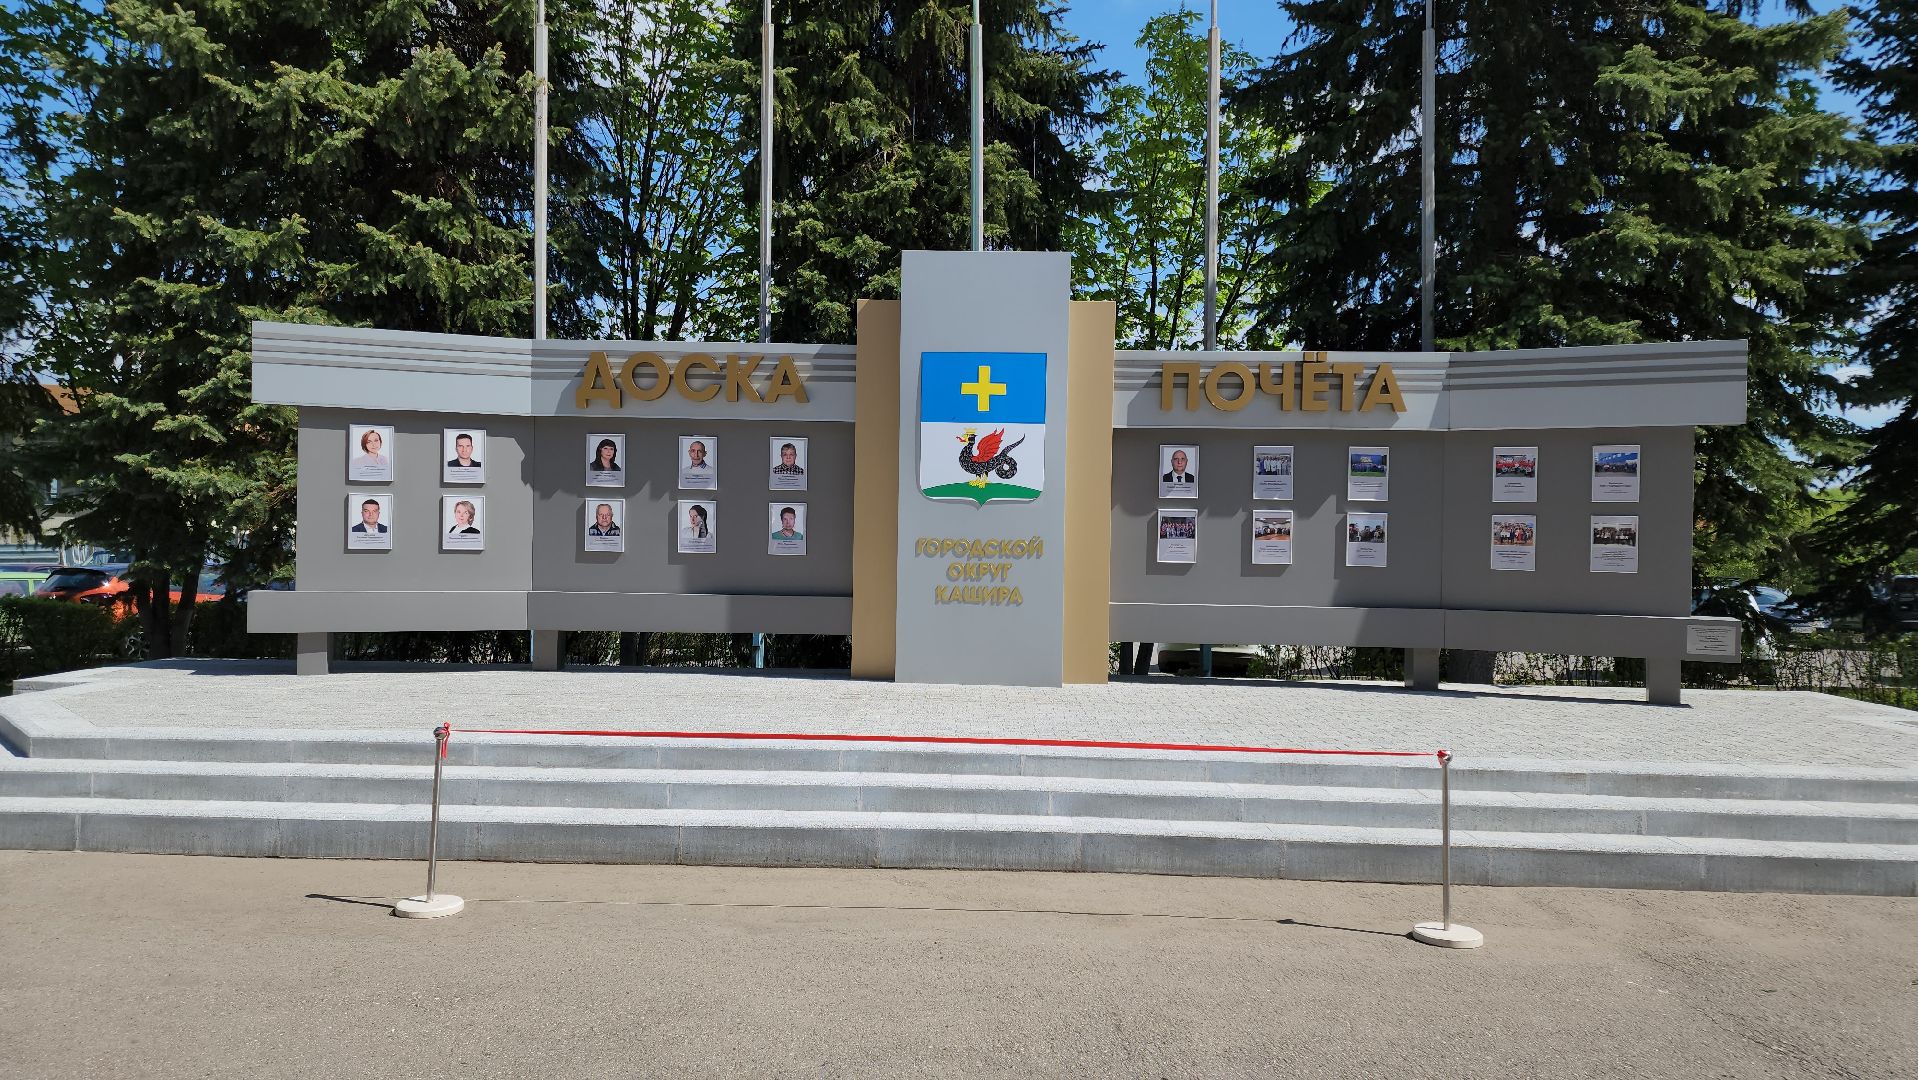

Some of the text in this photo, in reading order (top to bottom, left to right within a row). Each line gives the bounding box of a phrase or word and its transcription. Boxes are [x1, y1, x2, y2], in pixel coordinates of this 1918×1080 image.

[575, 351, 1407, 413] ДОСКА ПОЧЁТА
[915, 536, 1044, 560] ГОРОДСКОЙ
[946, 562, 1012, 582] ОКРУГ
[935, 585, 1024, 606] КАШИРА
